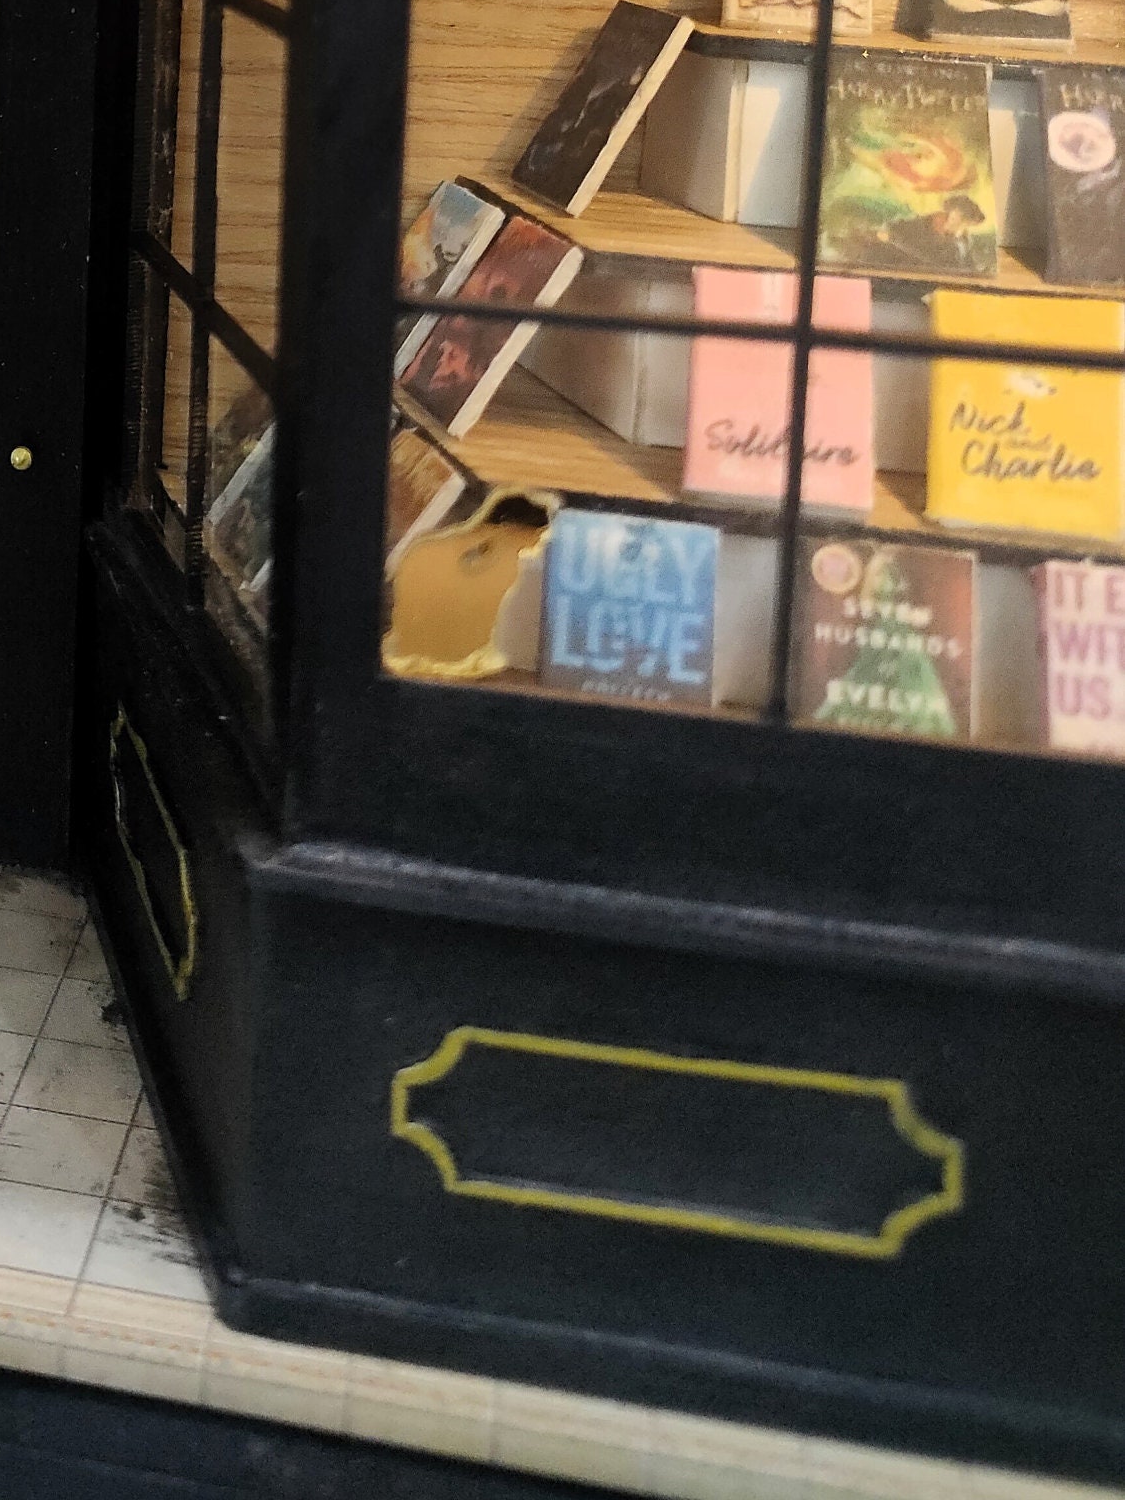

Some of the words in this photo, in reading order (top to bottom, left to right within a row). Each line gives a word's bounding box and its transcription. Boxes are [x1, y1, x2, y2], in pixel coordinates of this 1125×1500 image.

[704, 418, 860, 466] Solitire
[961, 439, 1103, 482] Charlie
[559, 523, 715, 605] UGLY
[1056, 672, 1112, 722] US
